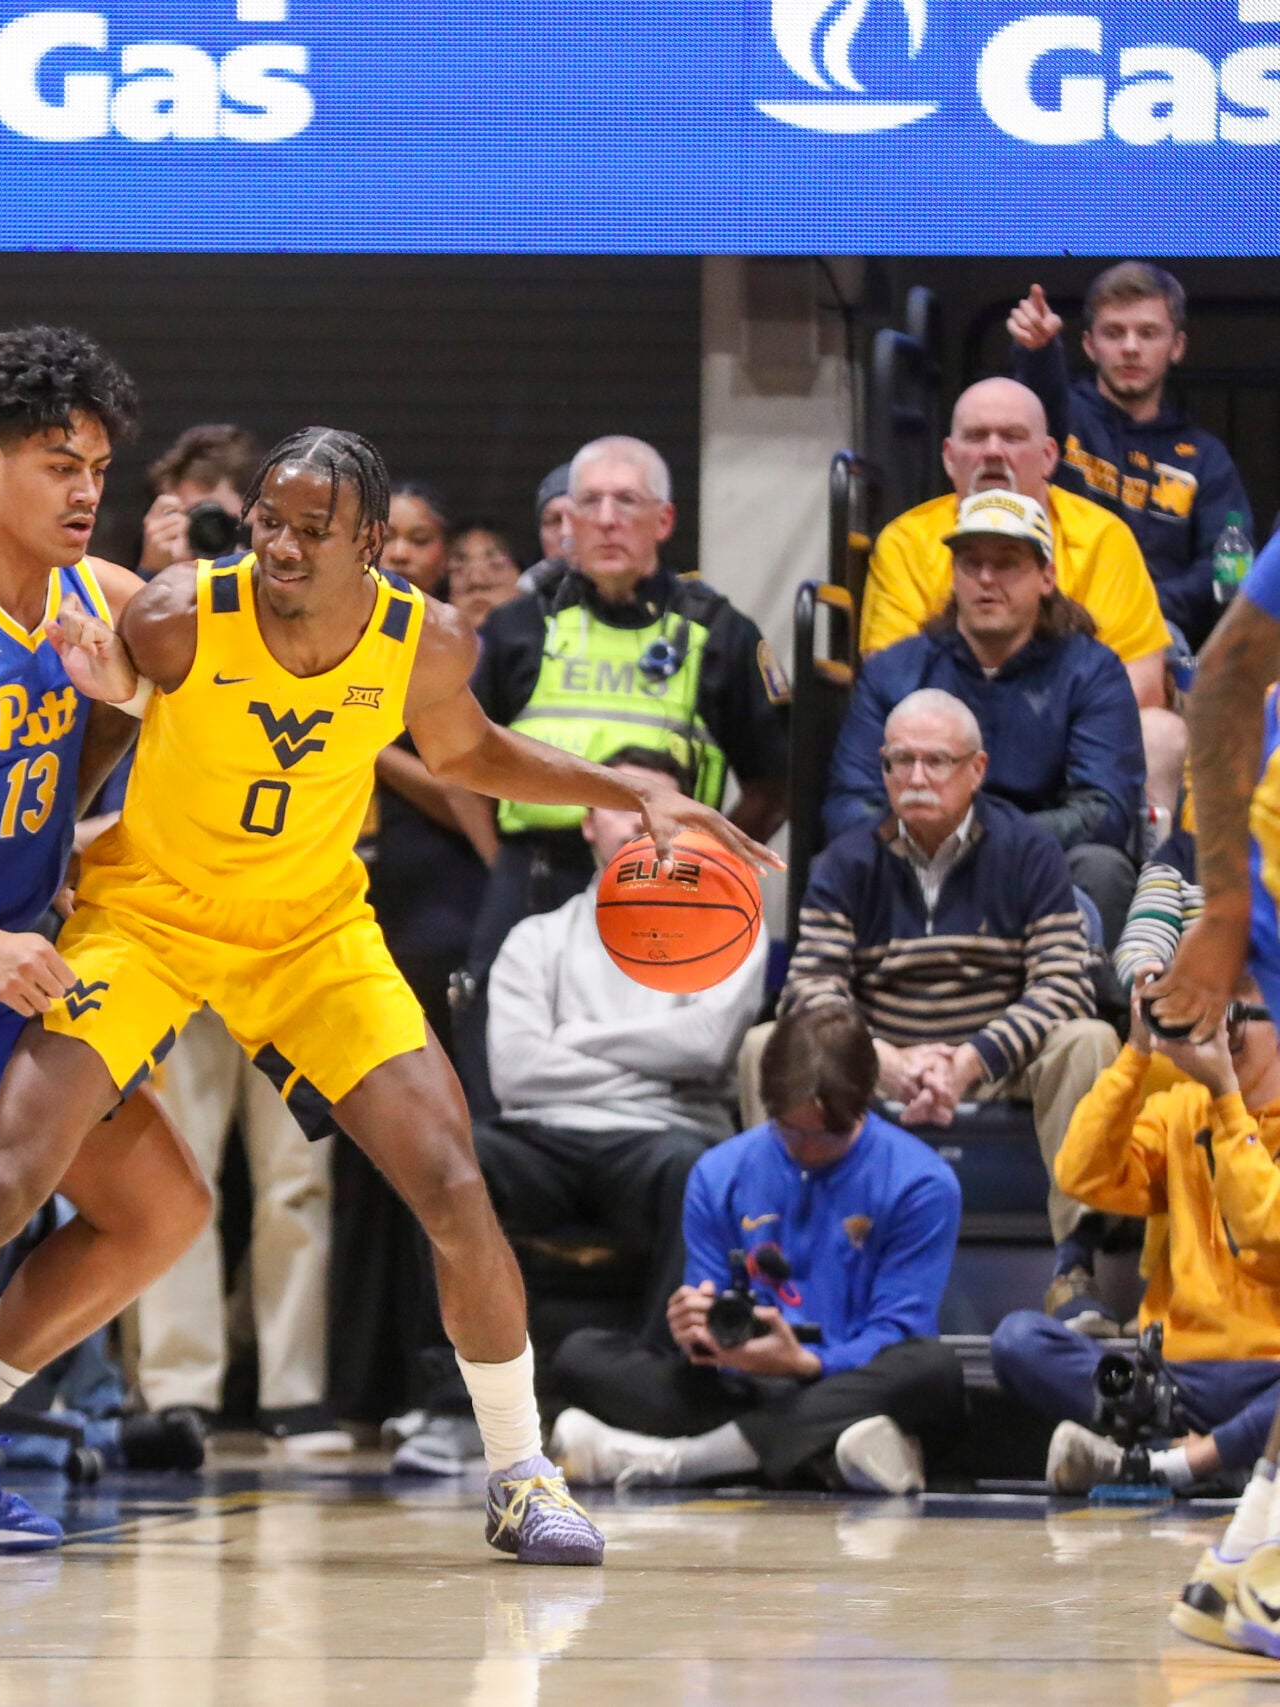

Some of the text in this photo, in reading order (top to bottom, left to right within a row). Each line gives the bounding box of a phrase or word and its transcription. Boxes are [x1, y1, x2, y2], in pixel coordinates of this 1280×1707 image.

[0, 751, 59, 838] 13
[239, 779, 291, 837] 0
[616, 859, 702, 885] ELIE
